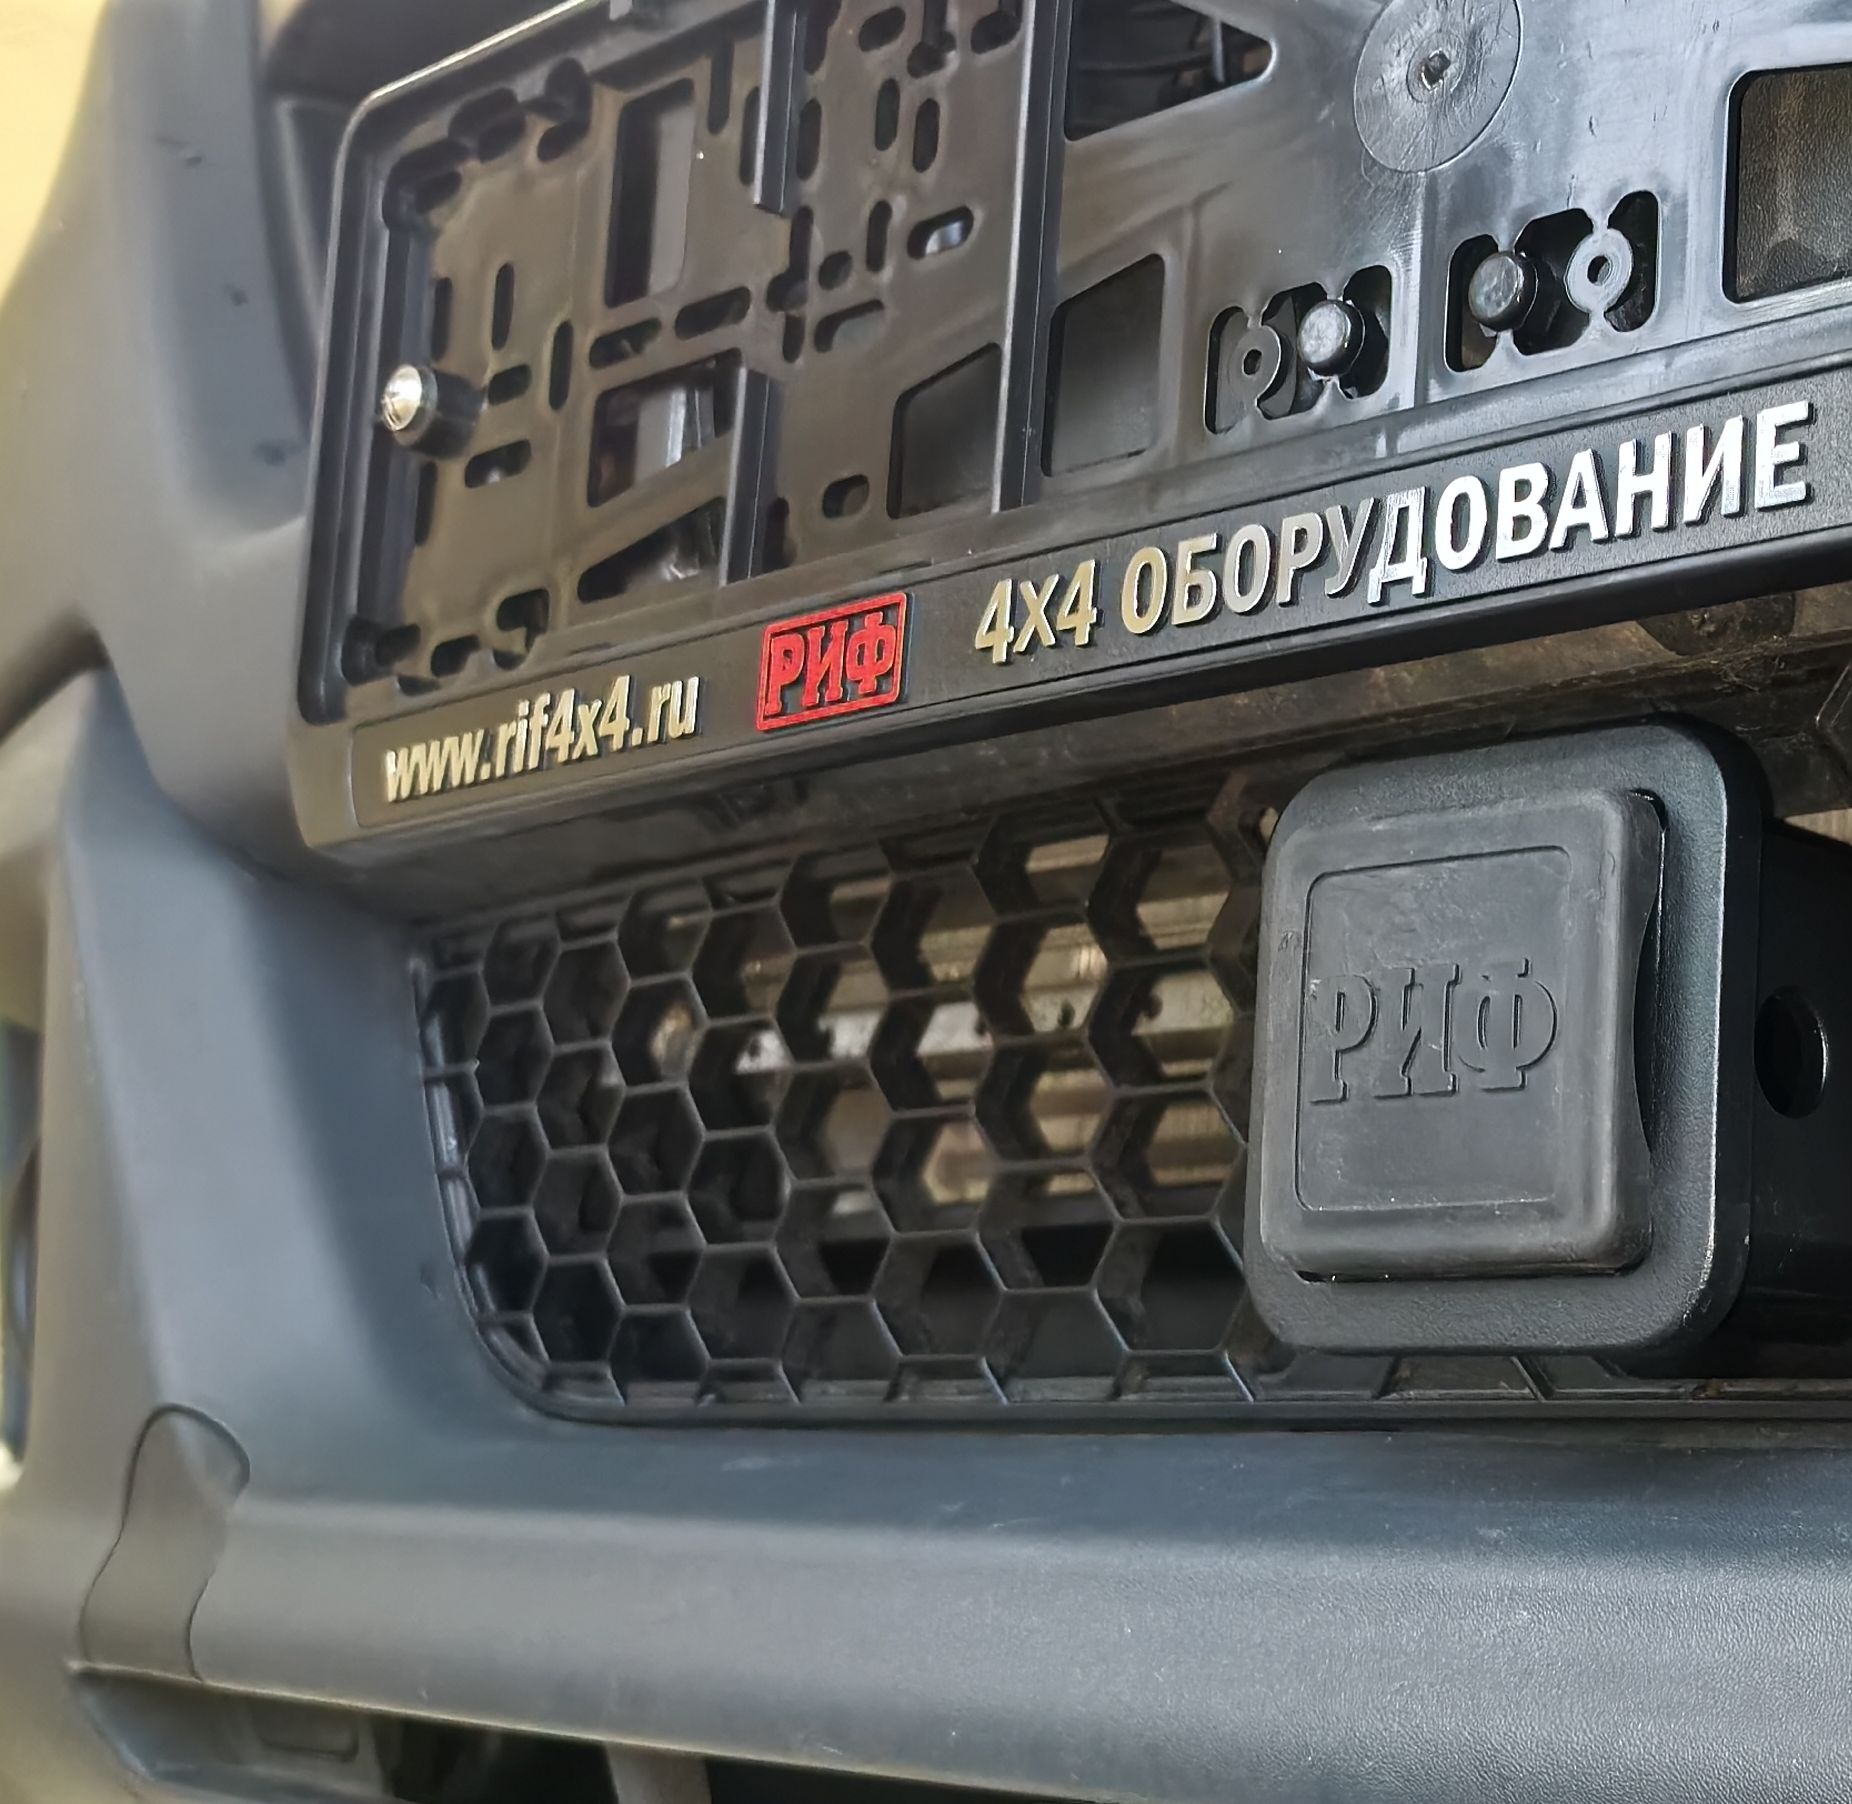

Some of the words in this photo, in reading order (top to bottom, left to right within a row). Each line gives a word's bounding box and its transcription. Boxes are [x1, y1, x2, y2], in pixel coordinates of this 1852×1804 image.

[1121, 400, 1812, 635] ОБОРУДОВАНИЕ
[766, 611, 897, 715] РИФ
[382, 674, 700, 803] www.rif4x4.ru
[1308, 958, 1558, 1105] РИФ
